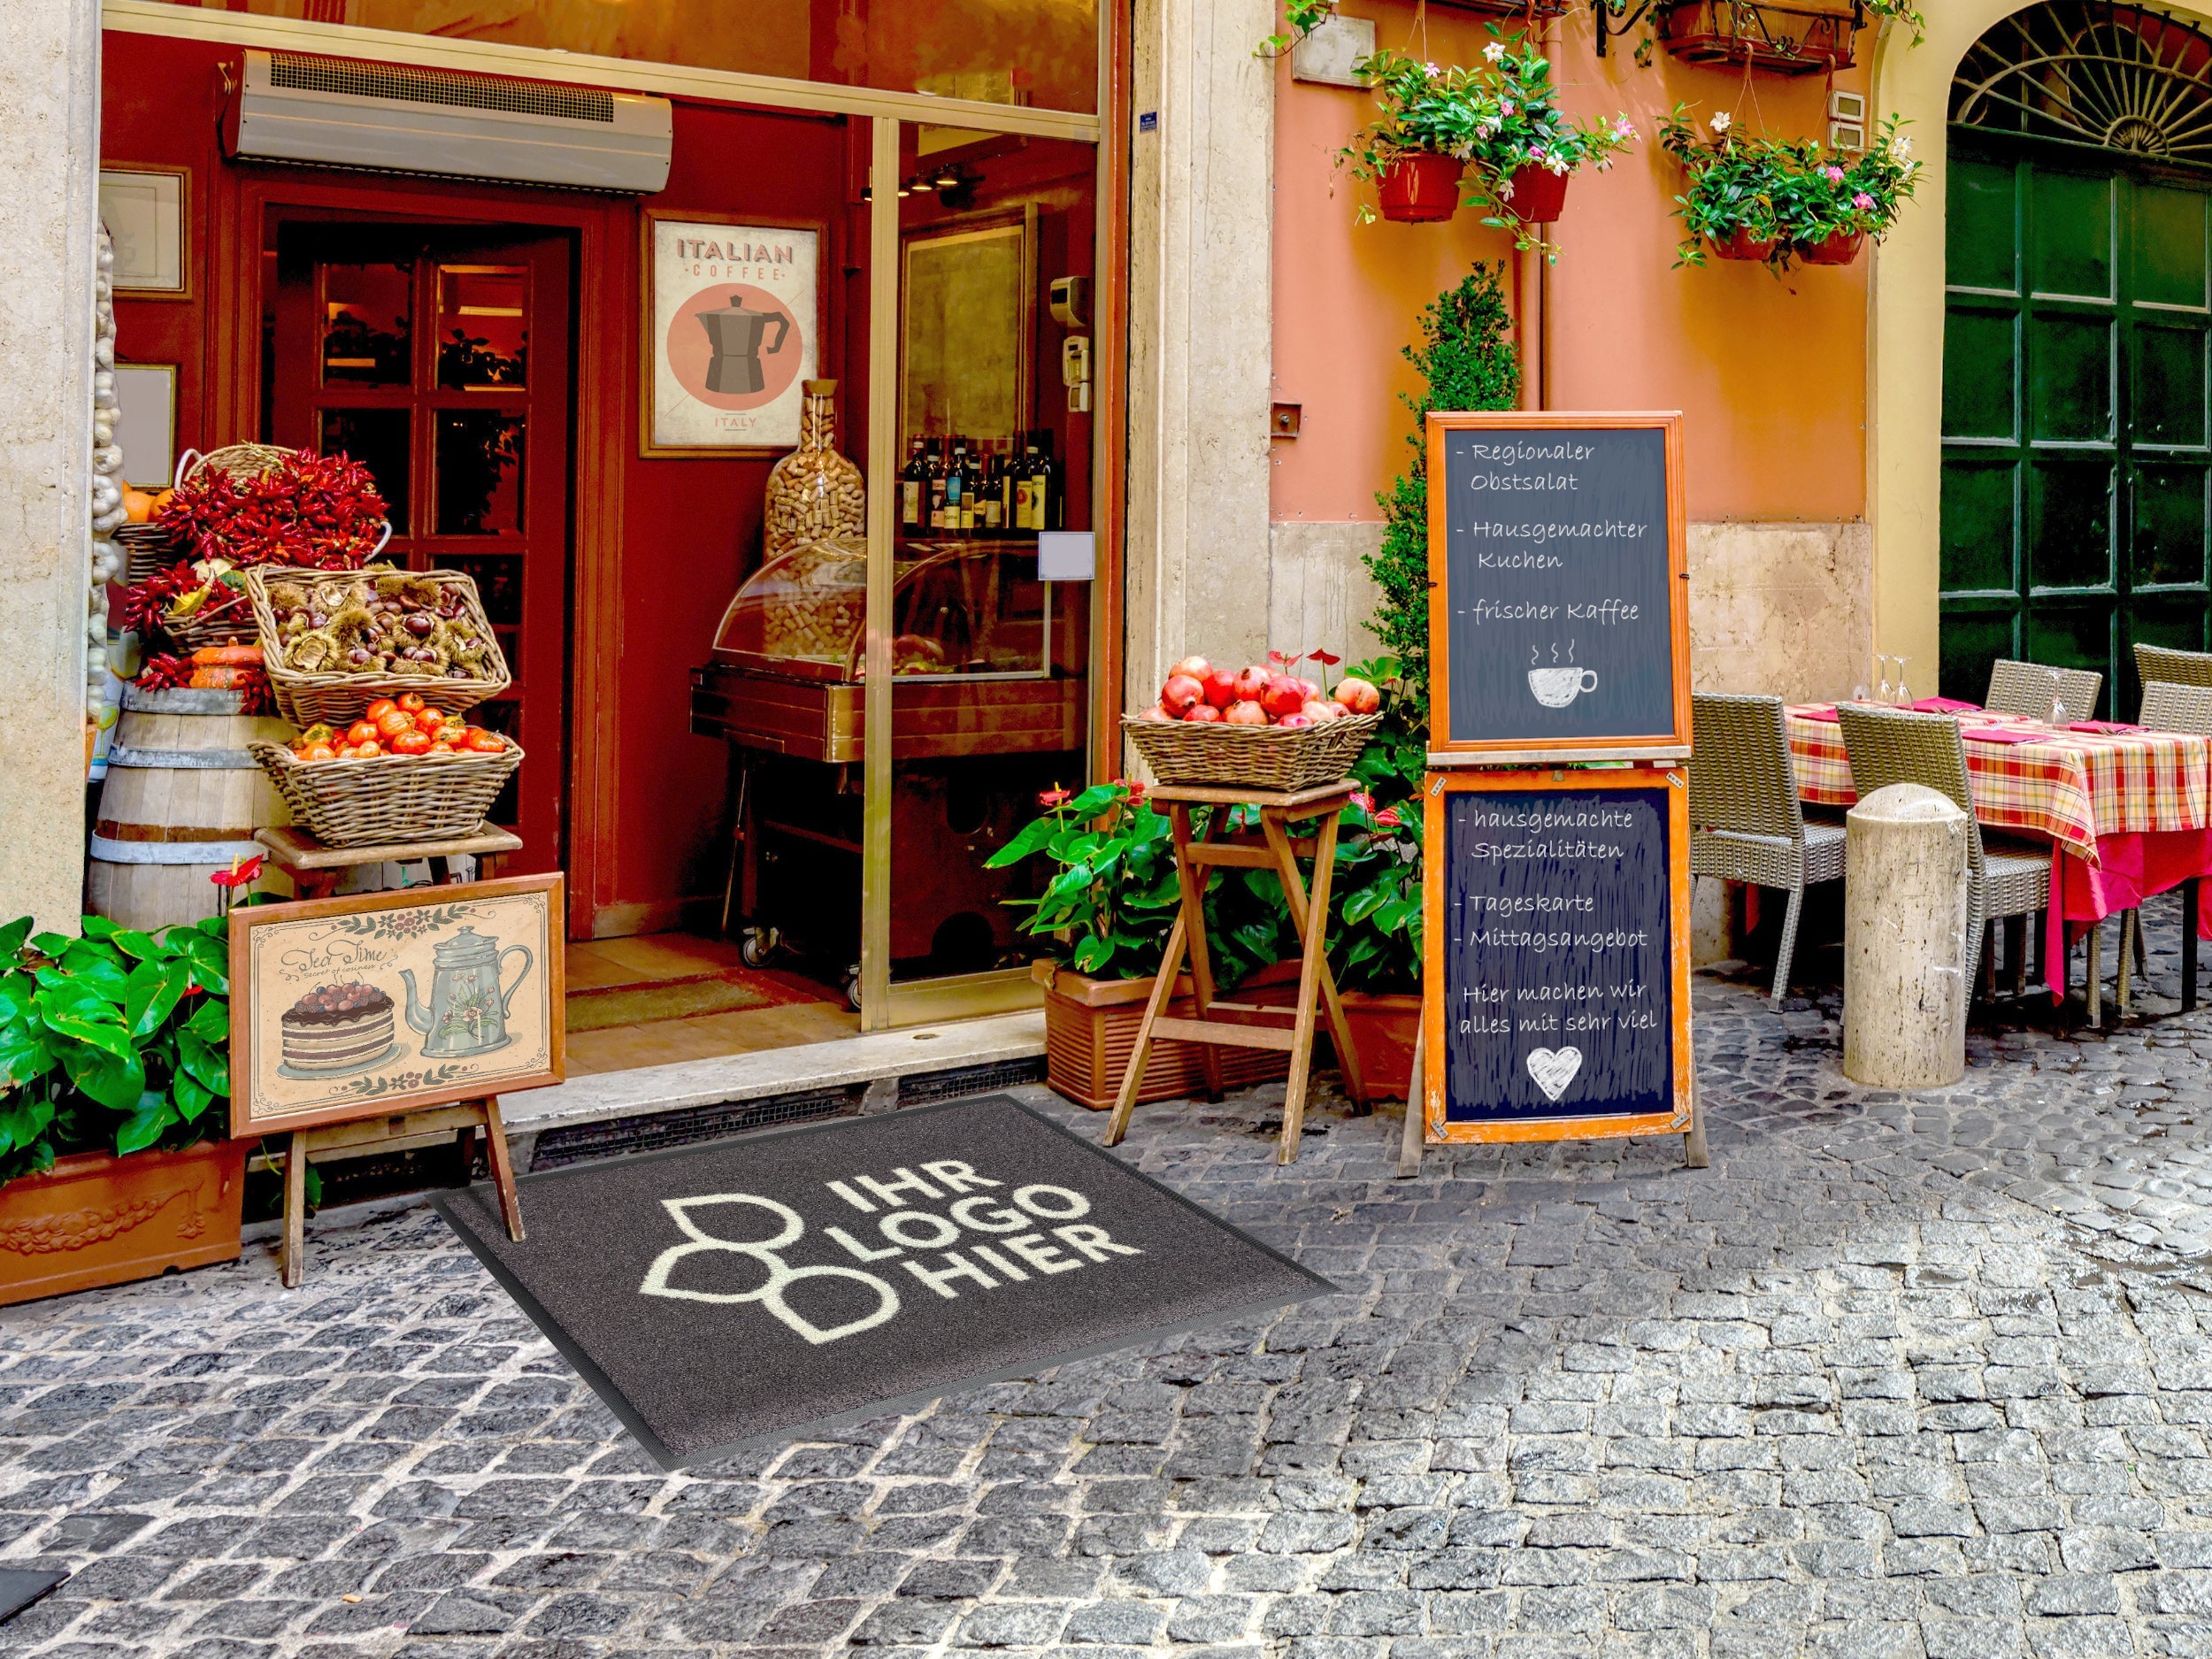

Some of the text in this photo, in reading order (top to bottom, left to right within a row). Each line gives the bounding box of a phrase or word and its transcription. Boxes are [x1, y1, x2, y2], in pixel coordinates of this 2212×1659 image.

[677, 238, 793, 264] ITALIAN
[693, 264, 780, 280] COFFEE
[714, 417, 757, 427] ITALY
[1471, 441, 1594, 465] Regionaler
[1471, 471, 1578, 490] Obstsalat
[1473, 519, 1647, 543] Hausgemachter
[1478, 550, 1563, 569] Kuchen
[1472, 599, 1559, 625] frischer
[1567, 599, 1639, 625] Kaffee
[1473, 810, 1632, 833] hausgemachte
[1471, 840, 1624, 864] Spezialitäten
[1470, 894, 1594, 917] Tageskarte
[1470, 927, 1647, 952] Mittagsangebot
[281, 939, 388, 972] Tea Time
[1463, 979, 1647, 1003] Hier machen wir
[1460, 1010, 1657, 1034] alles mit sehr viel
[824, 1159, 1004, 1213] IHR
[824, 1184, 1091, 1262] LOGO
[901, 1224, 1145, 1300] HIER
